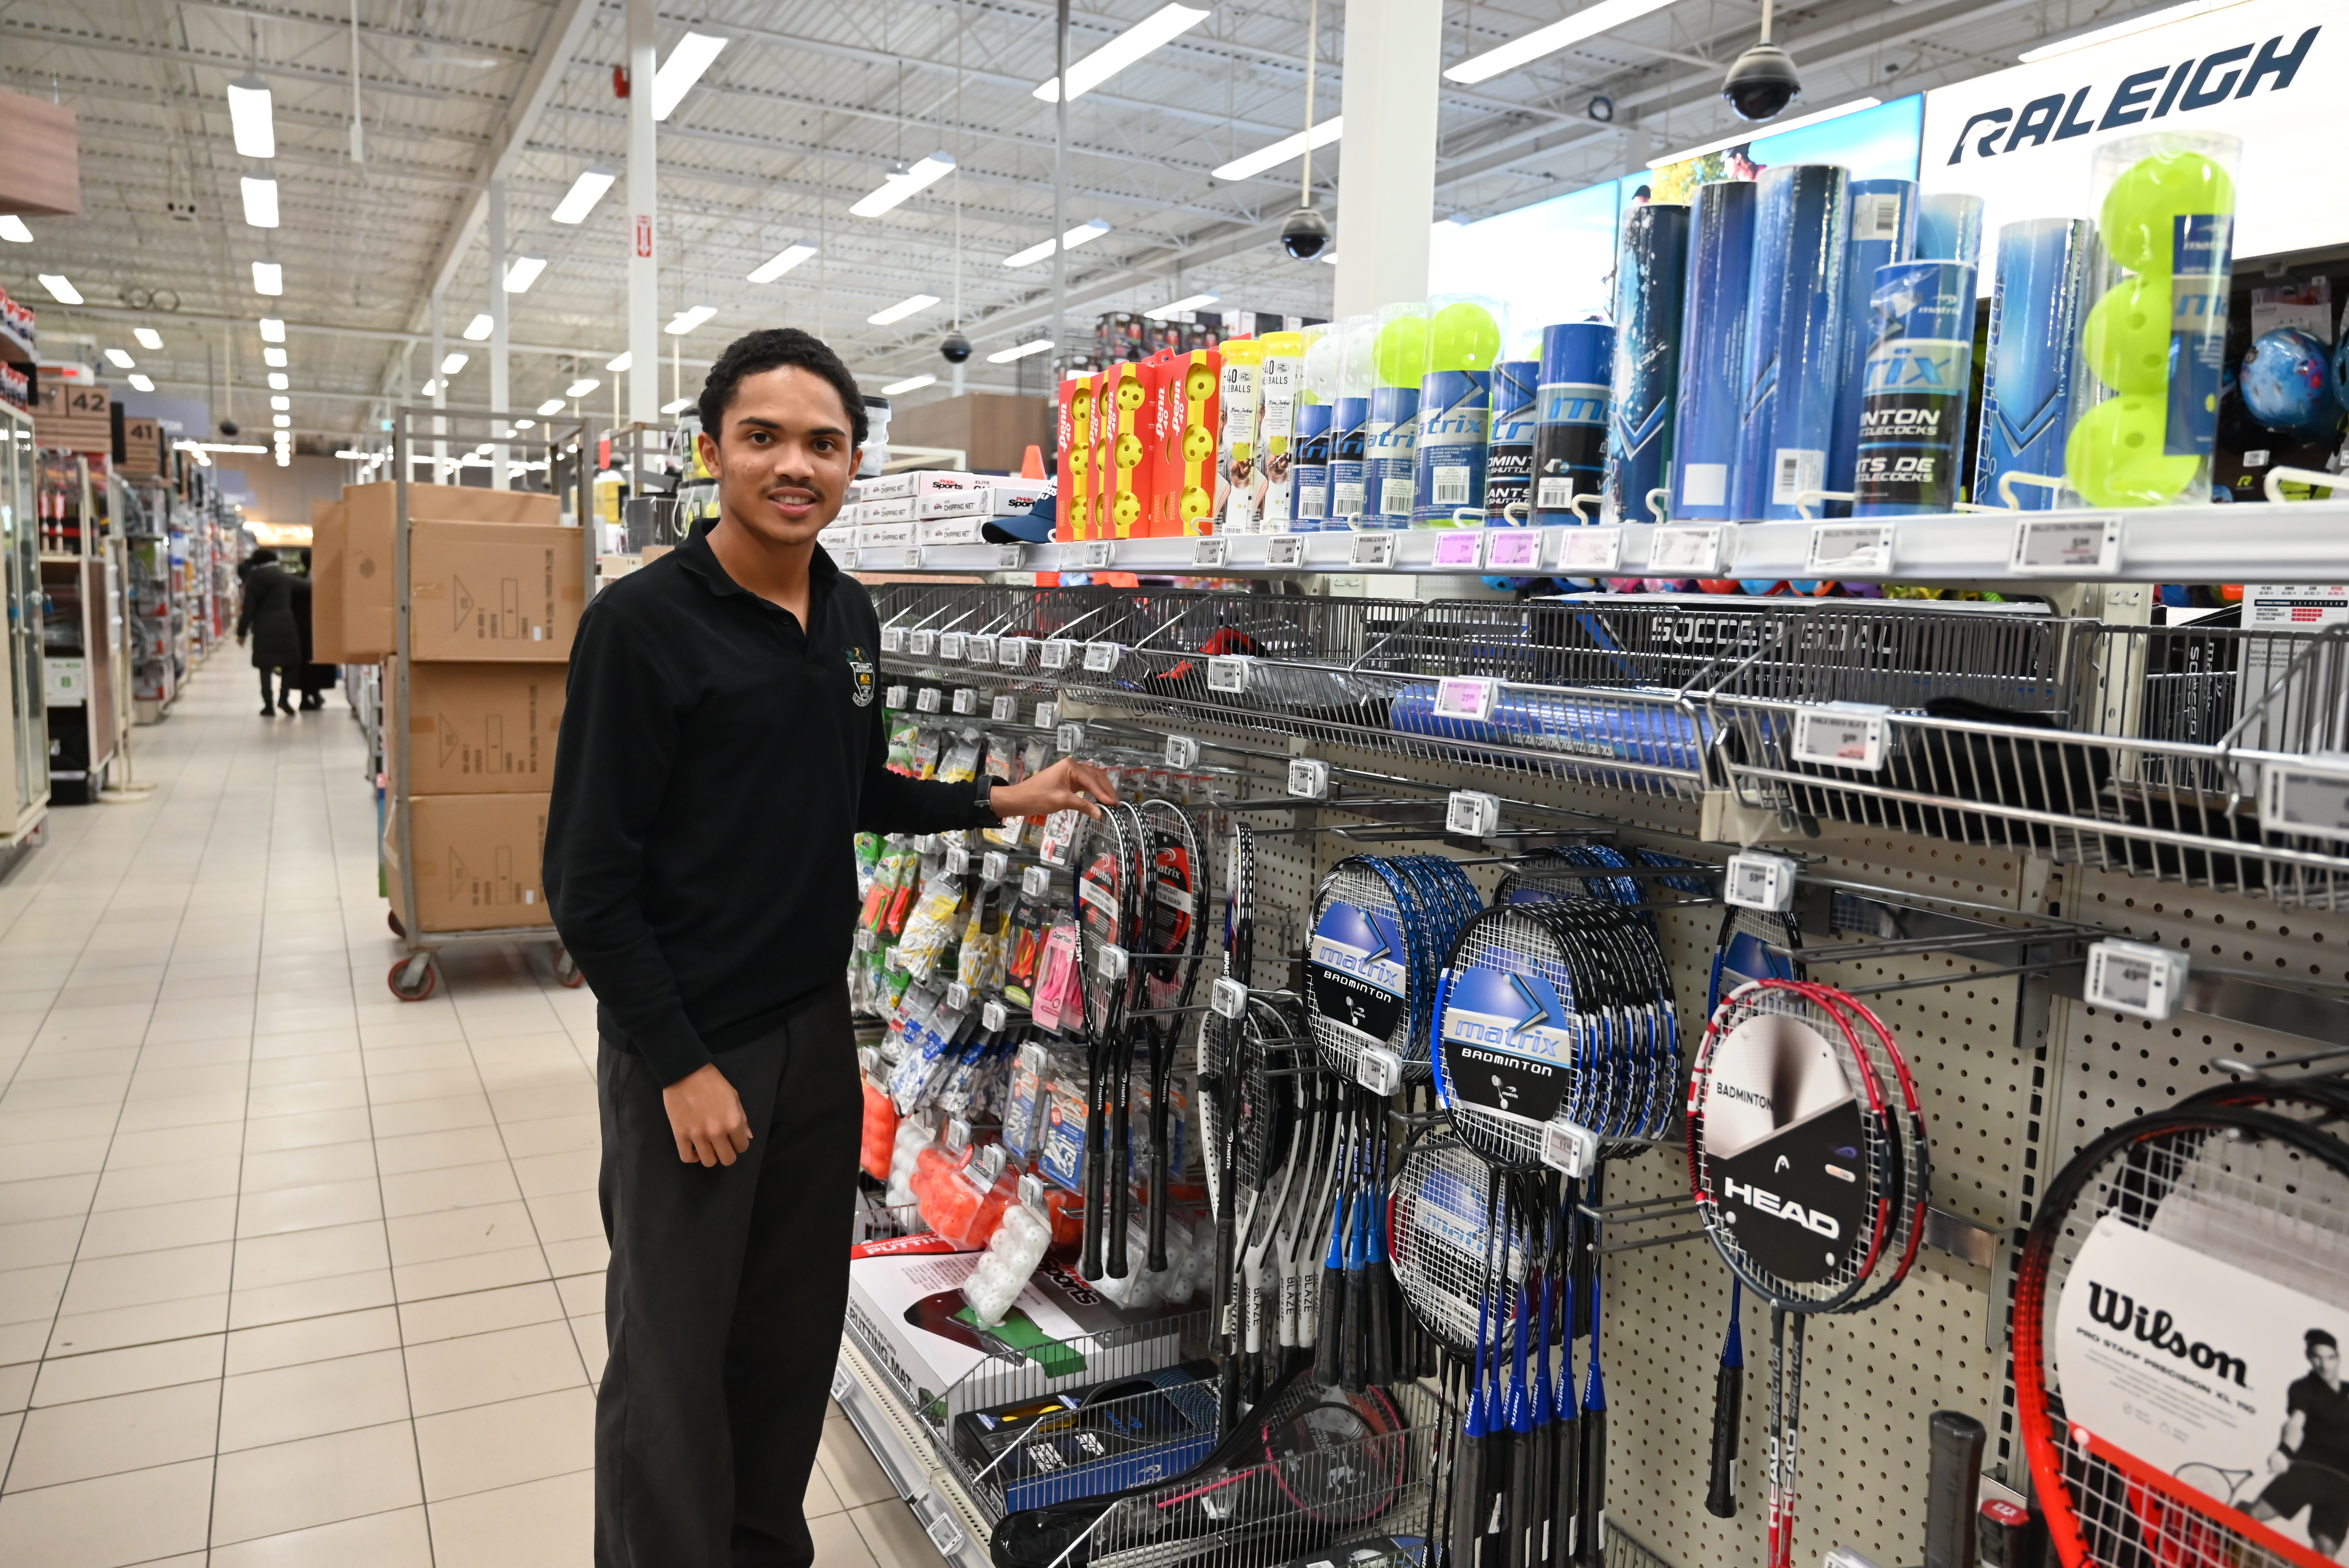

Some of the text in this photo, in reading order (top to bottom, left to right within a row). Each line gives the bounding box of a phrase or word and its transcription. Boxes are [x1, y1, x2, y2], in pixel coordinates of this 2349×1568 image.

[1946, 25, 2322, 166] RALEIGH
[1223, 369, 1237, 383] -40
[1262, 360, 1274, 375] -40
[1864, 348, 1951, 387] rix
[72, 393, 105, 412] 42
[1156, 386, 1165, 441] Penn
[1172, 379, 1181, 436] Penn
[1178, 403, 1184, 424] 40
[1094, 418, 1098, 437] 40
[1111, 413, 1116, 432] 40
[1162, 410, 1169, 430] 40
[1418, 415, 1483, 437] atrix
[1861, 409, 1941, 427] INTON
[132, 424, 153, 439] 41
[1066, 423, 1071, 442] 40
[1368, 431, 1415, 448] atri
[1294, 442, 1328, 458] tri
[1330, 437, 1364, 453] tri
[1895, 457, 1936, 472] DE
[932, 481, 963, 490] Sports
[1008, 499, 1035, 508] Sport
[1652, 617, 1783, 647] SOCCER
[1091, 866, 1113, 886] matrix
[1090, 885, 1111, 902] SQUASH RACQUET
[1162, 884, 1178, 896] RACQUET
[1167, 894, 1181, 906] SQUASH
[1087, 892, 1101, 904] RAQUETTE
[1104, 901, 1113, 912] SQUASH
[1319, 946, 1398, 987] matrix
[1324, 970, 1392, 1003] BADMINTON
[1353, 1010, 1366, 1018] matrix
[1455, 1020, 1559, 1057] matrix
[1461, 1048, 1552, 1076] BADMINTON
[1502, 1090, 1518, 1099] matrix
[1716, 1082, 1773, 1112] BADMINTON
[973, 1160, 988, 1174] Sports
[1725, 1176, 1839, 1240] HEAD
[863, 1234, 931, 1249] CONTINUOUS
[1424, 1212, 1485, 1252] matr
[866, 1235, 946, 1255] PUTTIN
[1035, 1257, 1100, 1305] Sports
[1286, 1277, 1295, 1315] BLAZE
[1304, 1275, 1313, 1312] BLAZE
[850, 1296, 896, 1356] CONTINUOUS RETURN
[2089, 1280, 2247, 1388] Wilson
[850, 1306, 912, 1391] PUTTING MAT
[2076, 1327, 2099, 1342] PRO
[2103, 1339, 2140, 1359] STAFF
[2144, 1358, 2212, 1394] PRECISION
[2215, 1390, 2231, 1404] XL
[1771, 1346, 1780, 1427] SPECTOR
[1790, 1340, 1800, 1418] SPECTOR
[1503, 1382, 1511, 1415] matrix
[1511, 1392, 1519, 1427] matrix
[1465, 1394, 1474, 1430] matrix
[1769, 1437, 1780, 1528] HEAD
[1782, 1429, 1796, 1516] HEAD
